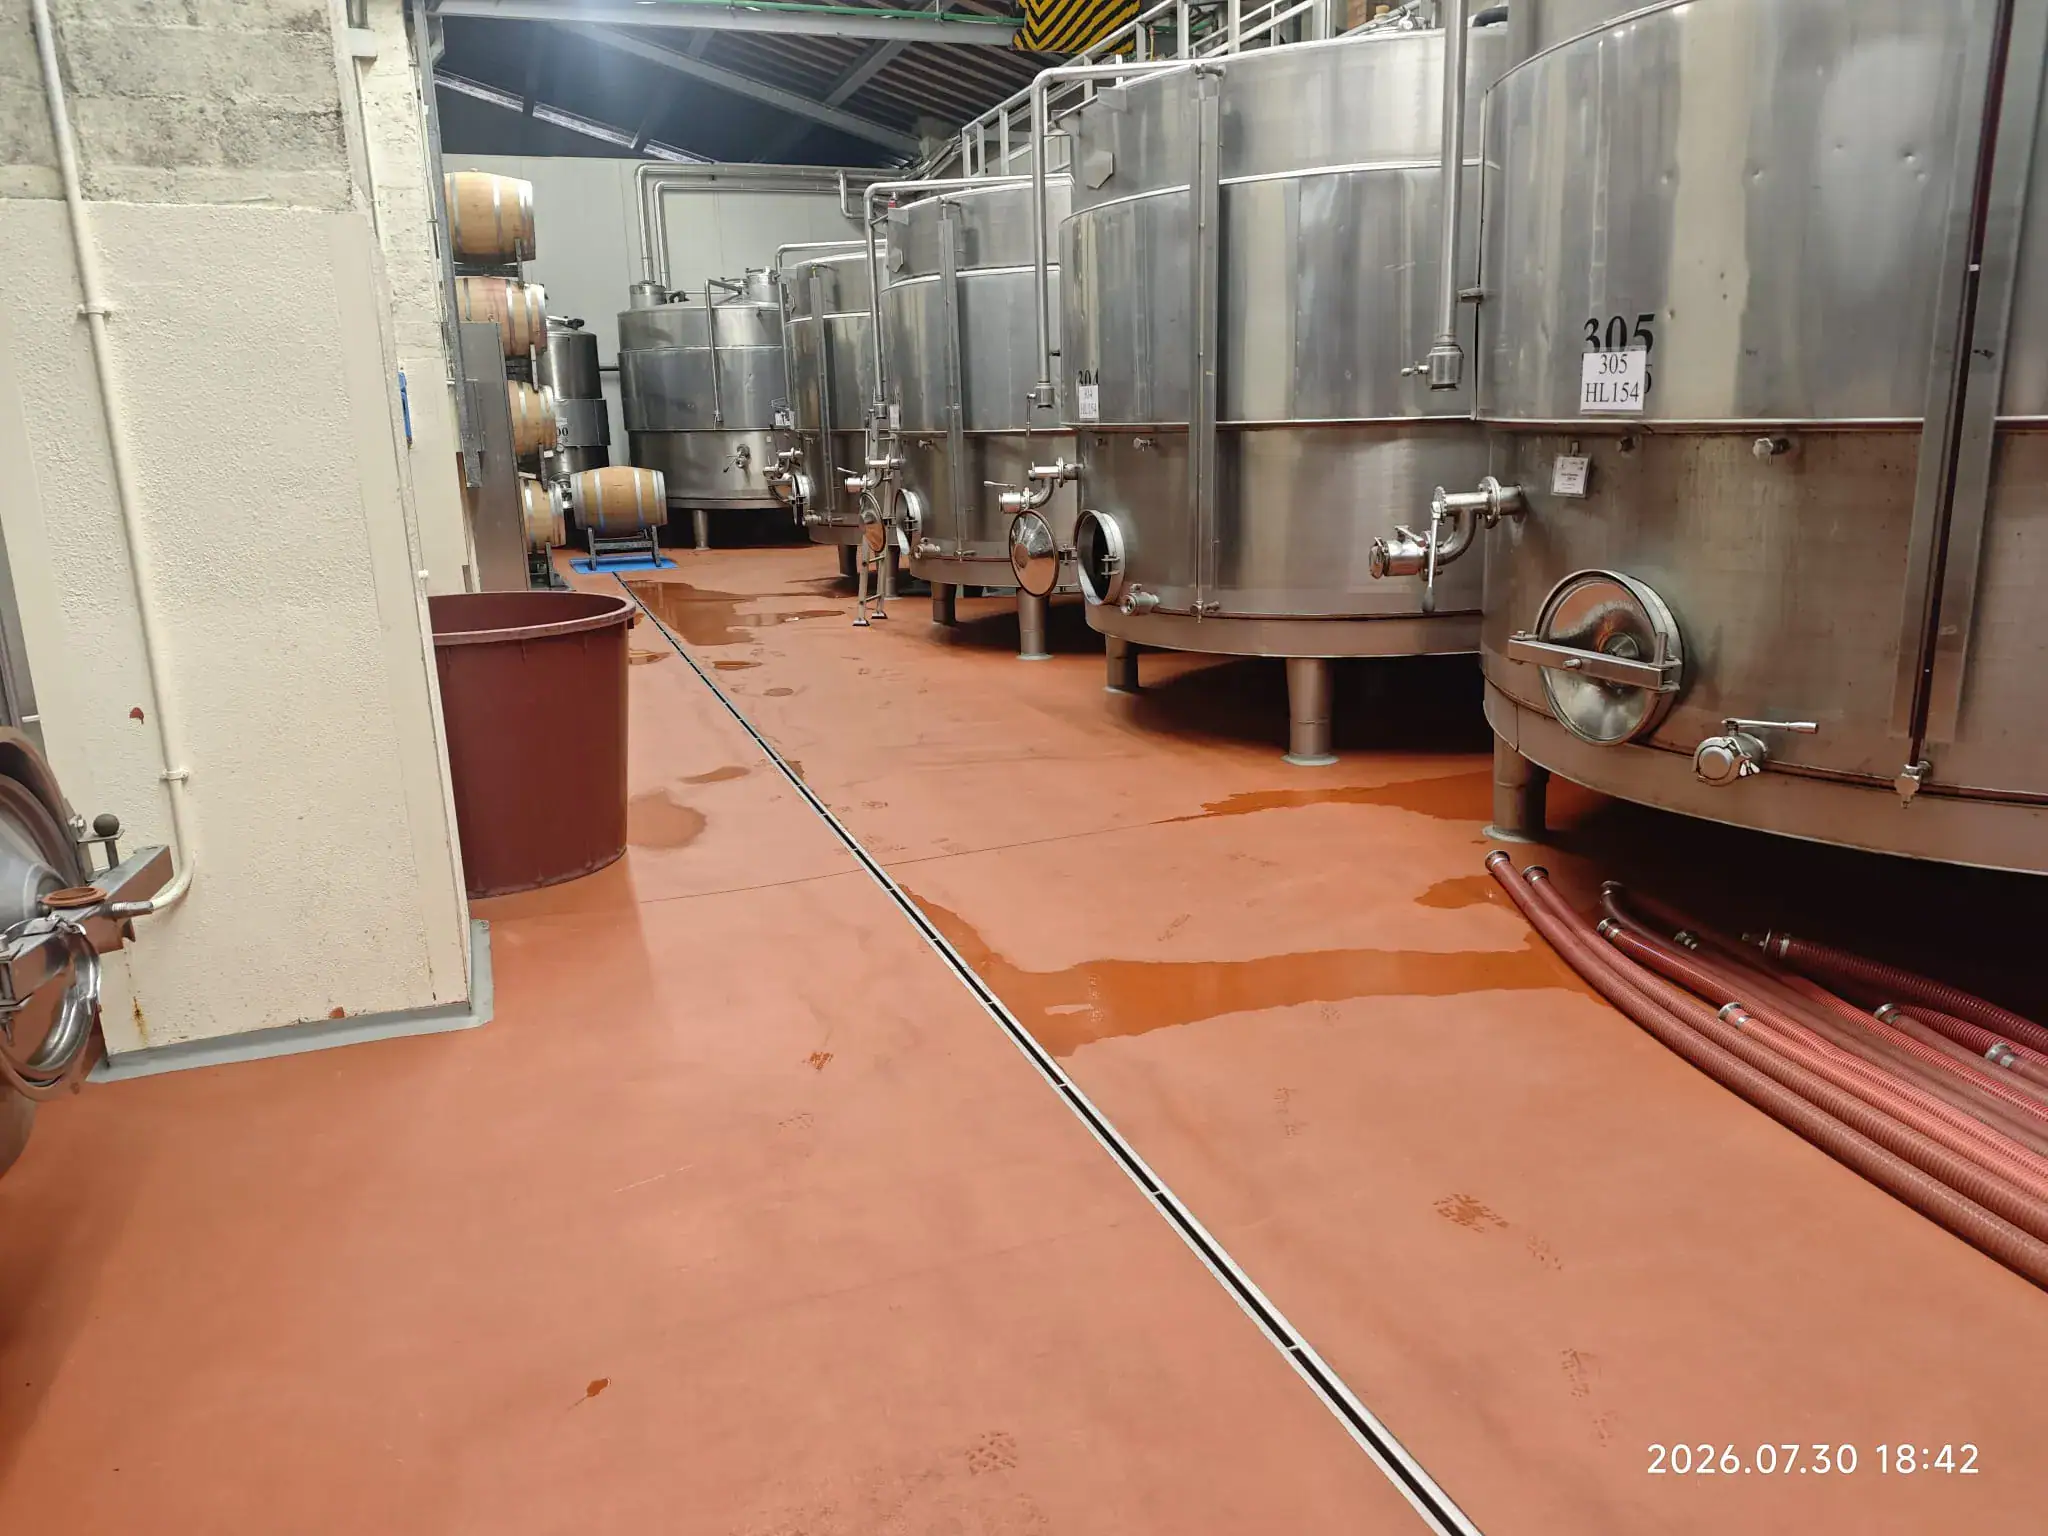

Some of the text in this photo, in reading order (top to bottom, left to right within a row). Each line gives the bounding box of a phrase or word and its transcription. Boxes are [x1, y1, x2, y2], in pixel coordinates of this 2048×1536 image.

[1584, 313, 1655, 354] 305
[1598, 353, 1628, 375] 305
[1585, 382, 1639, 402] HL154
